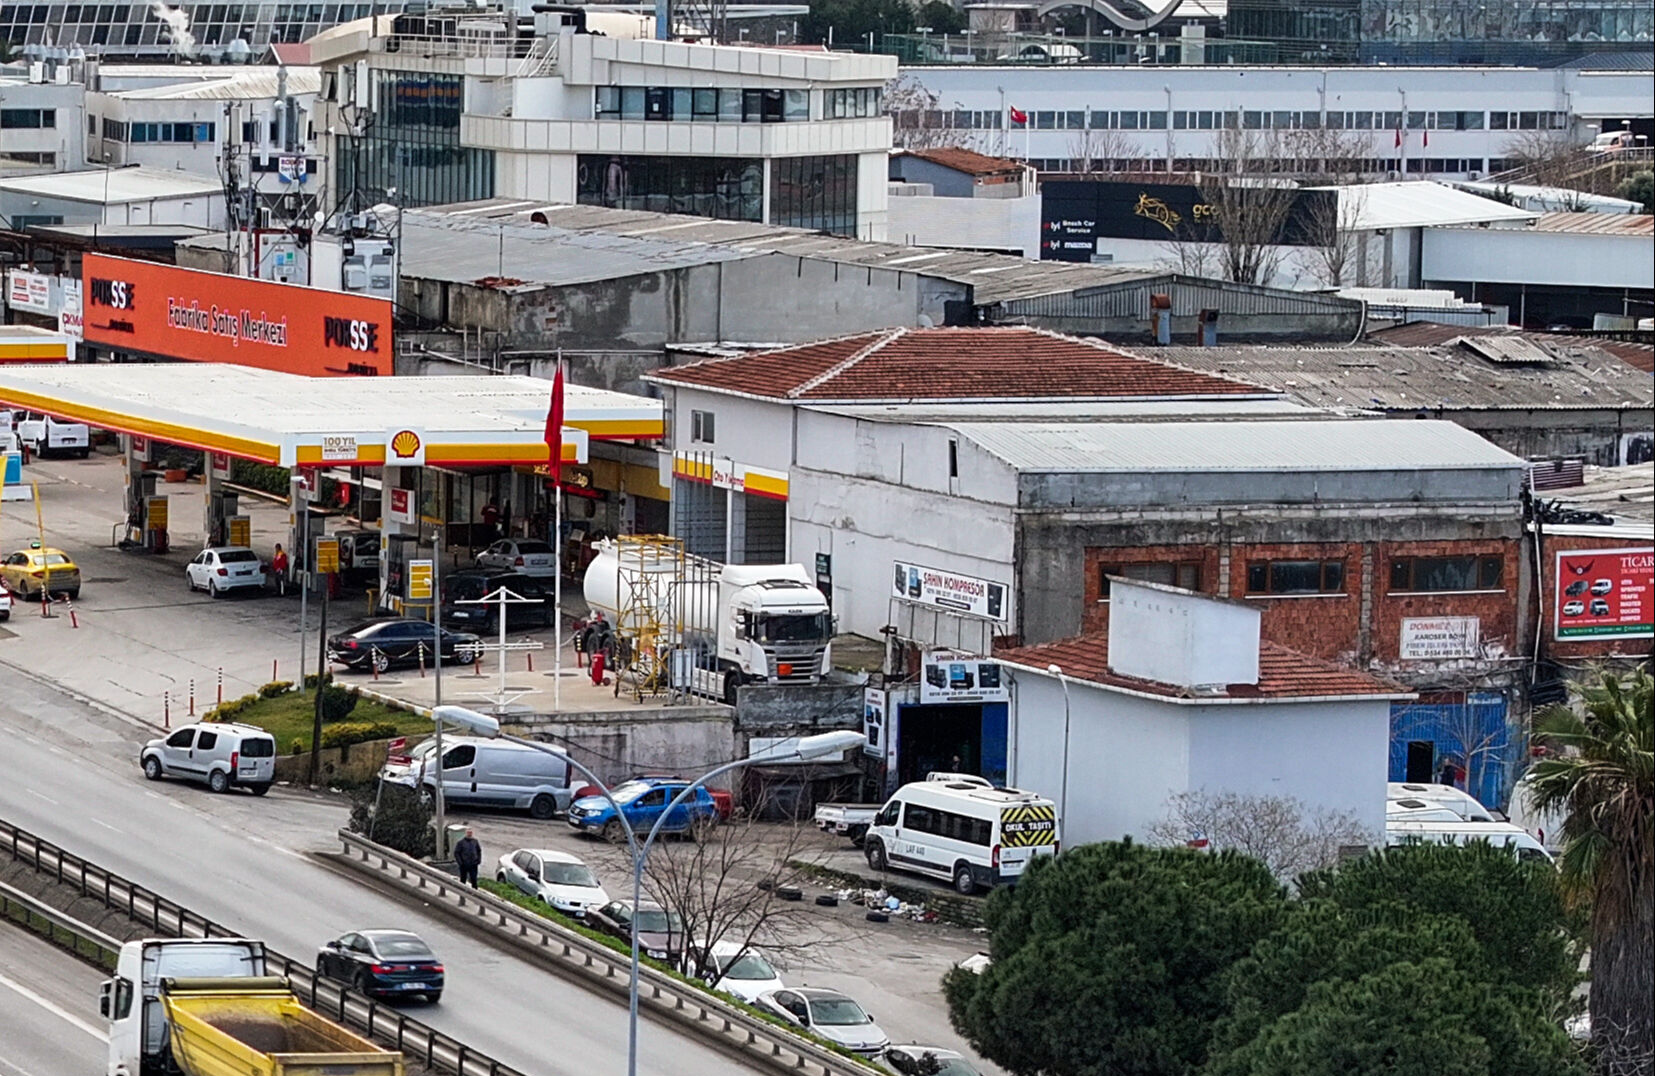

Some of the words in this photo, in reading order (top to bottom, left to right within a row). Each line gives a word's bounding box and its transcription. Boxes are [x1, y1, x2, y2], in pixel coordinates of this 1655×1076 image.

[168, 297, 209, 333] Fabrika
[212, 304, 238, 347] Satış
[241, 309, 288, 348] Merkezi
[324, 437, 341, 445] 100
[344, 437, 357, 445] YIL
[1006, 822, 1025, 831] OKUL
